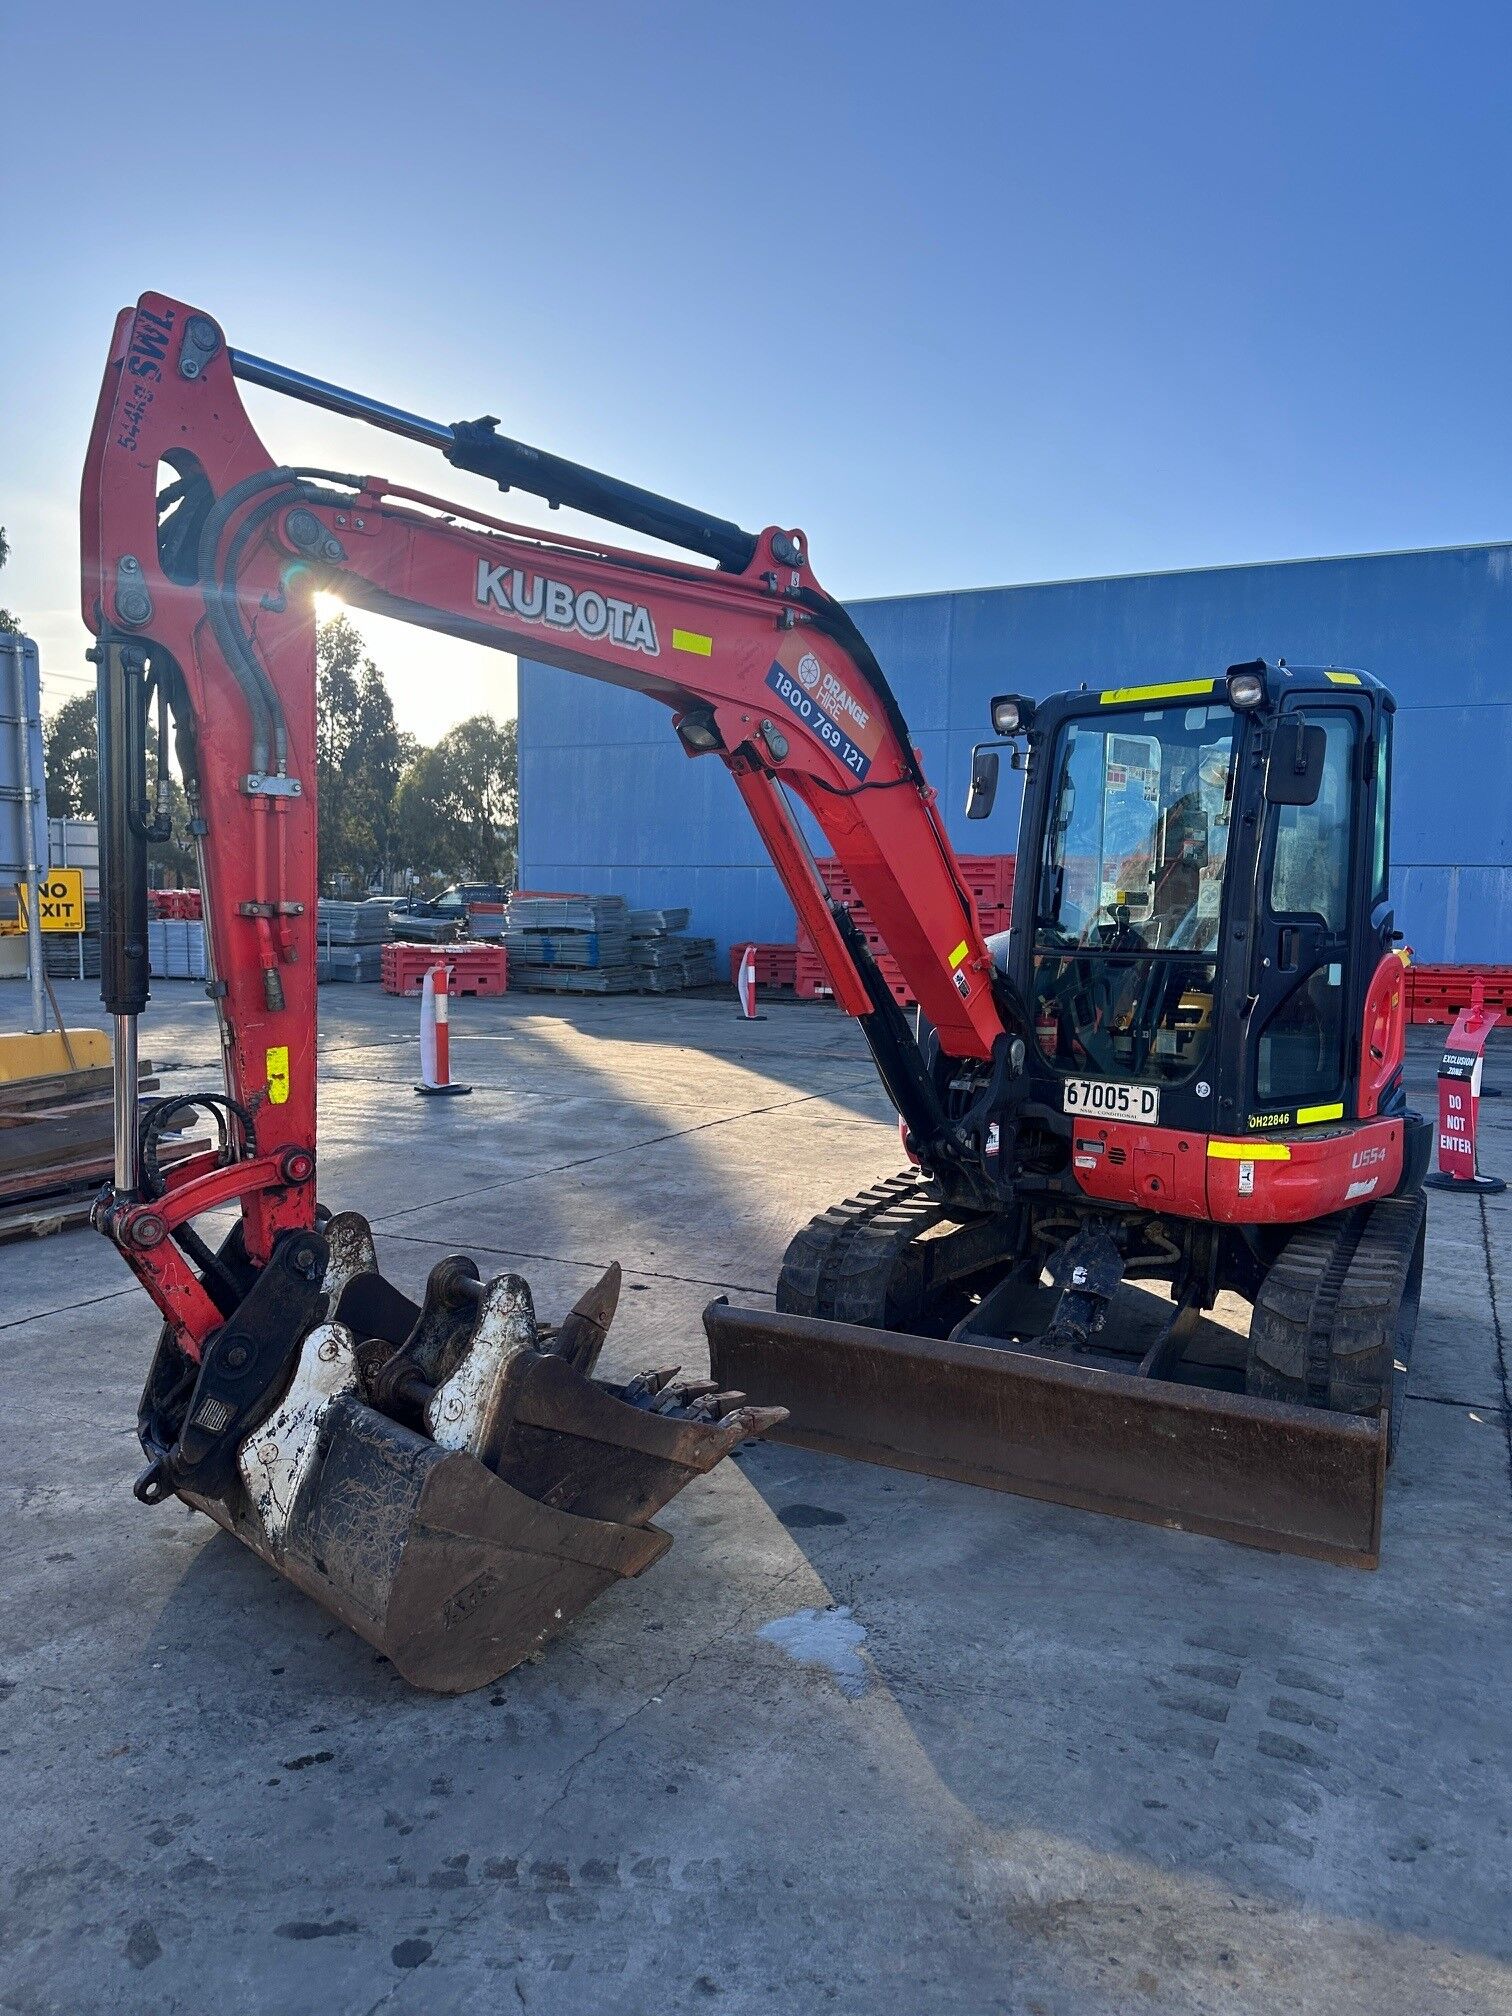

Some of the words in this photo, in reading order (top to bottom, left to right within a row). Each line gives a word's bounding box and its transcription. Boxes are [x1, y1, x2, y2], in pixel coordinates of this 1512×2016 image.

[128, 308, 176, 383] SWL
[475, 558, 658, 654] KUBOTA
[815, 686, 844, 722] HIRE
[823, 673, 870, 730] ORANGE
[774, 671, 812, 717] 1800
[812, 713, 841, 748] 769
[842, 742, 864, 773] 121
[41, 903, 75, 918] XIT
[1442, 1054, 1476, 1067] EXCLUSION
[1447, 1066, 1464, 1076] ZONE
[1448, 1094, 1462, 1111] DO
[1097, 1110, 1137, 1120] CONDITIONAL
[1249, 1113, 1290, 1128] OH22846
[1446, 1114, 1466, 1132] NOT
[1440, 1134, 1472, 1155] ENTER
